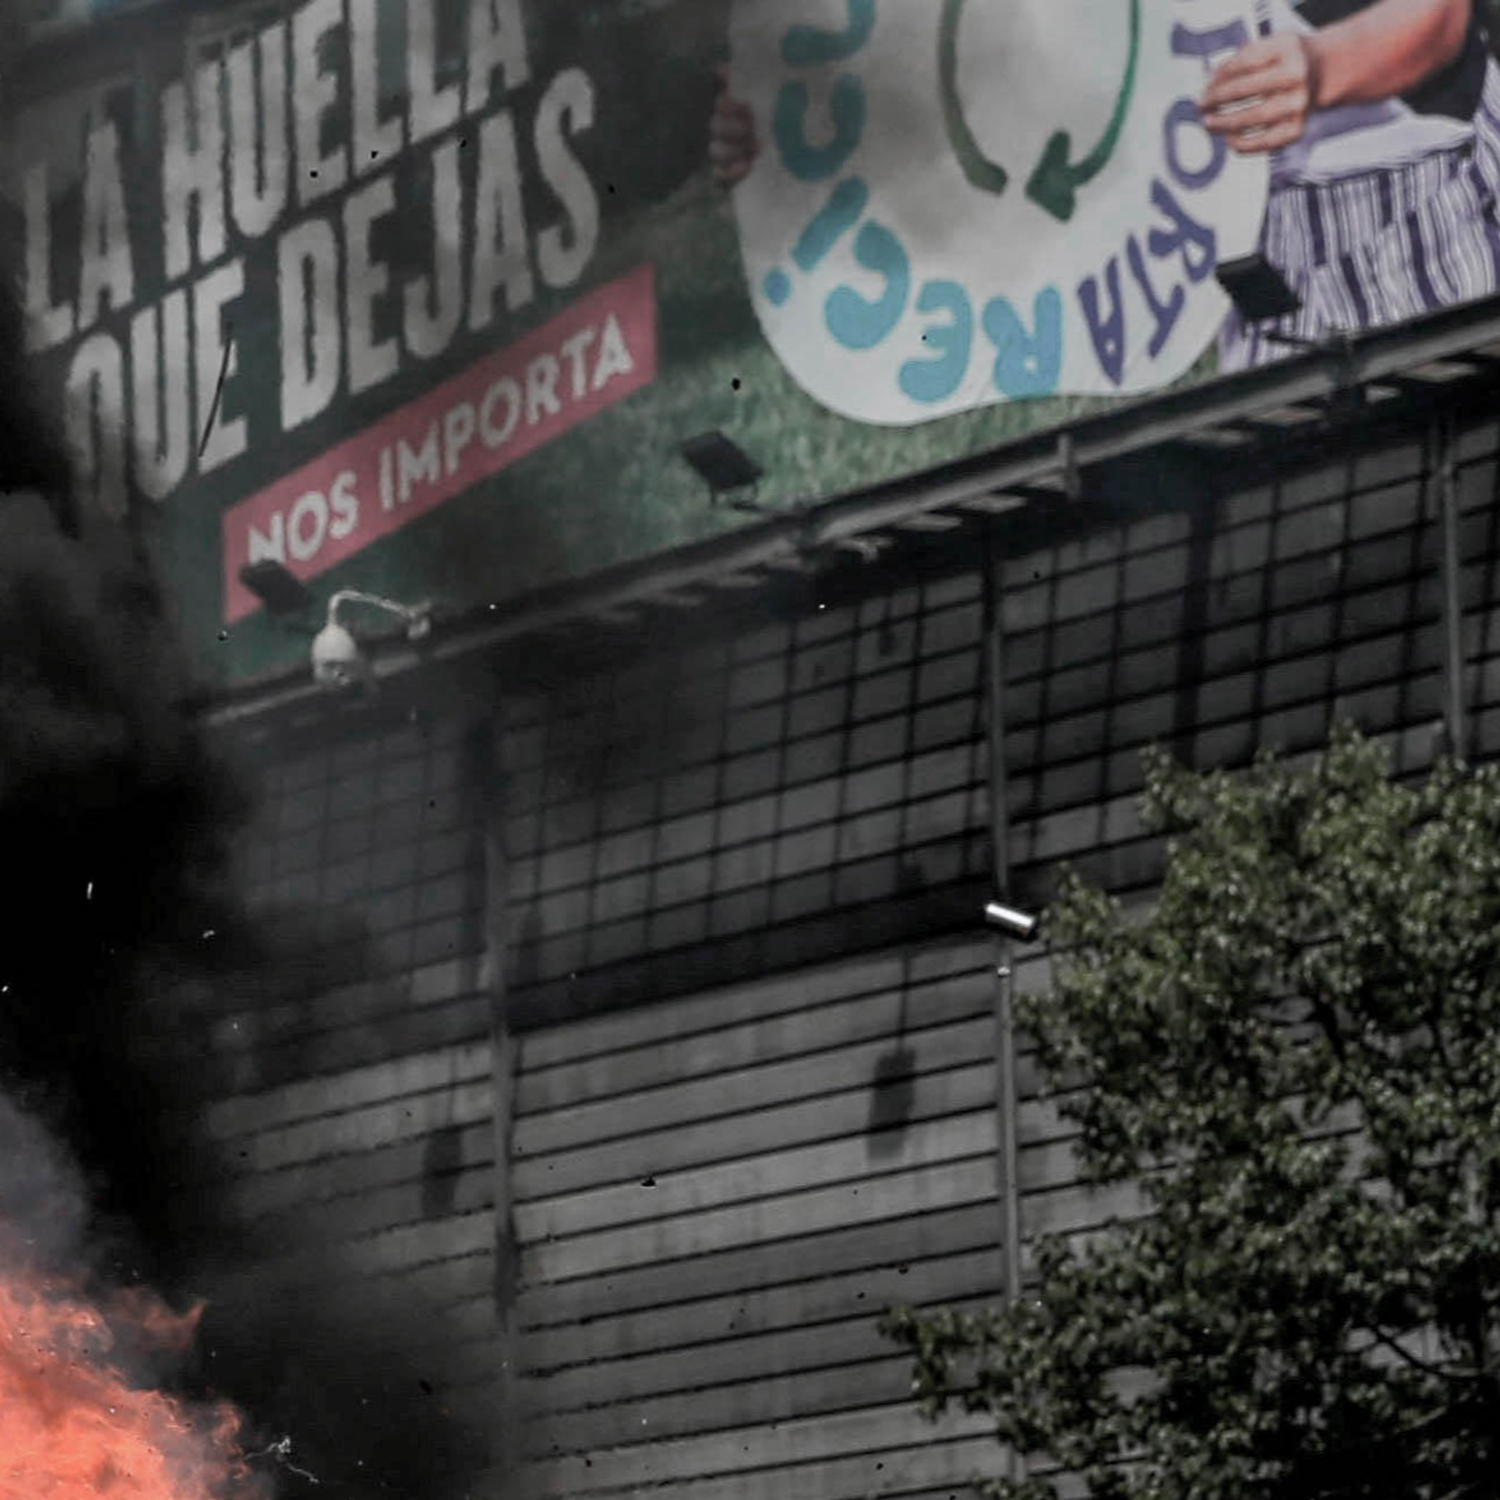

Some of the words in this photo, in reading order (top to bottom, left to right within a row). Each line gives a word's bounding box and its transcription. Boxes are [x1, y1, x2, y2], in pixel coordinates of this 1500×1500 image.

[23, 118, 134, 354] LA
[160, 0, 531, 286] HUELLA
[277, 66, 599, 432] DEJAS
[246, 470, 361, 567] NOS
[379, 312, 636, 512] IMPORTA
